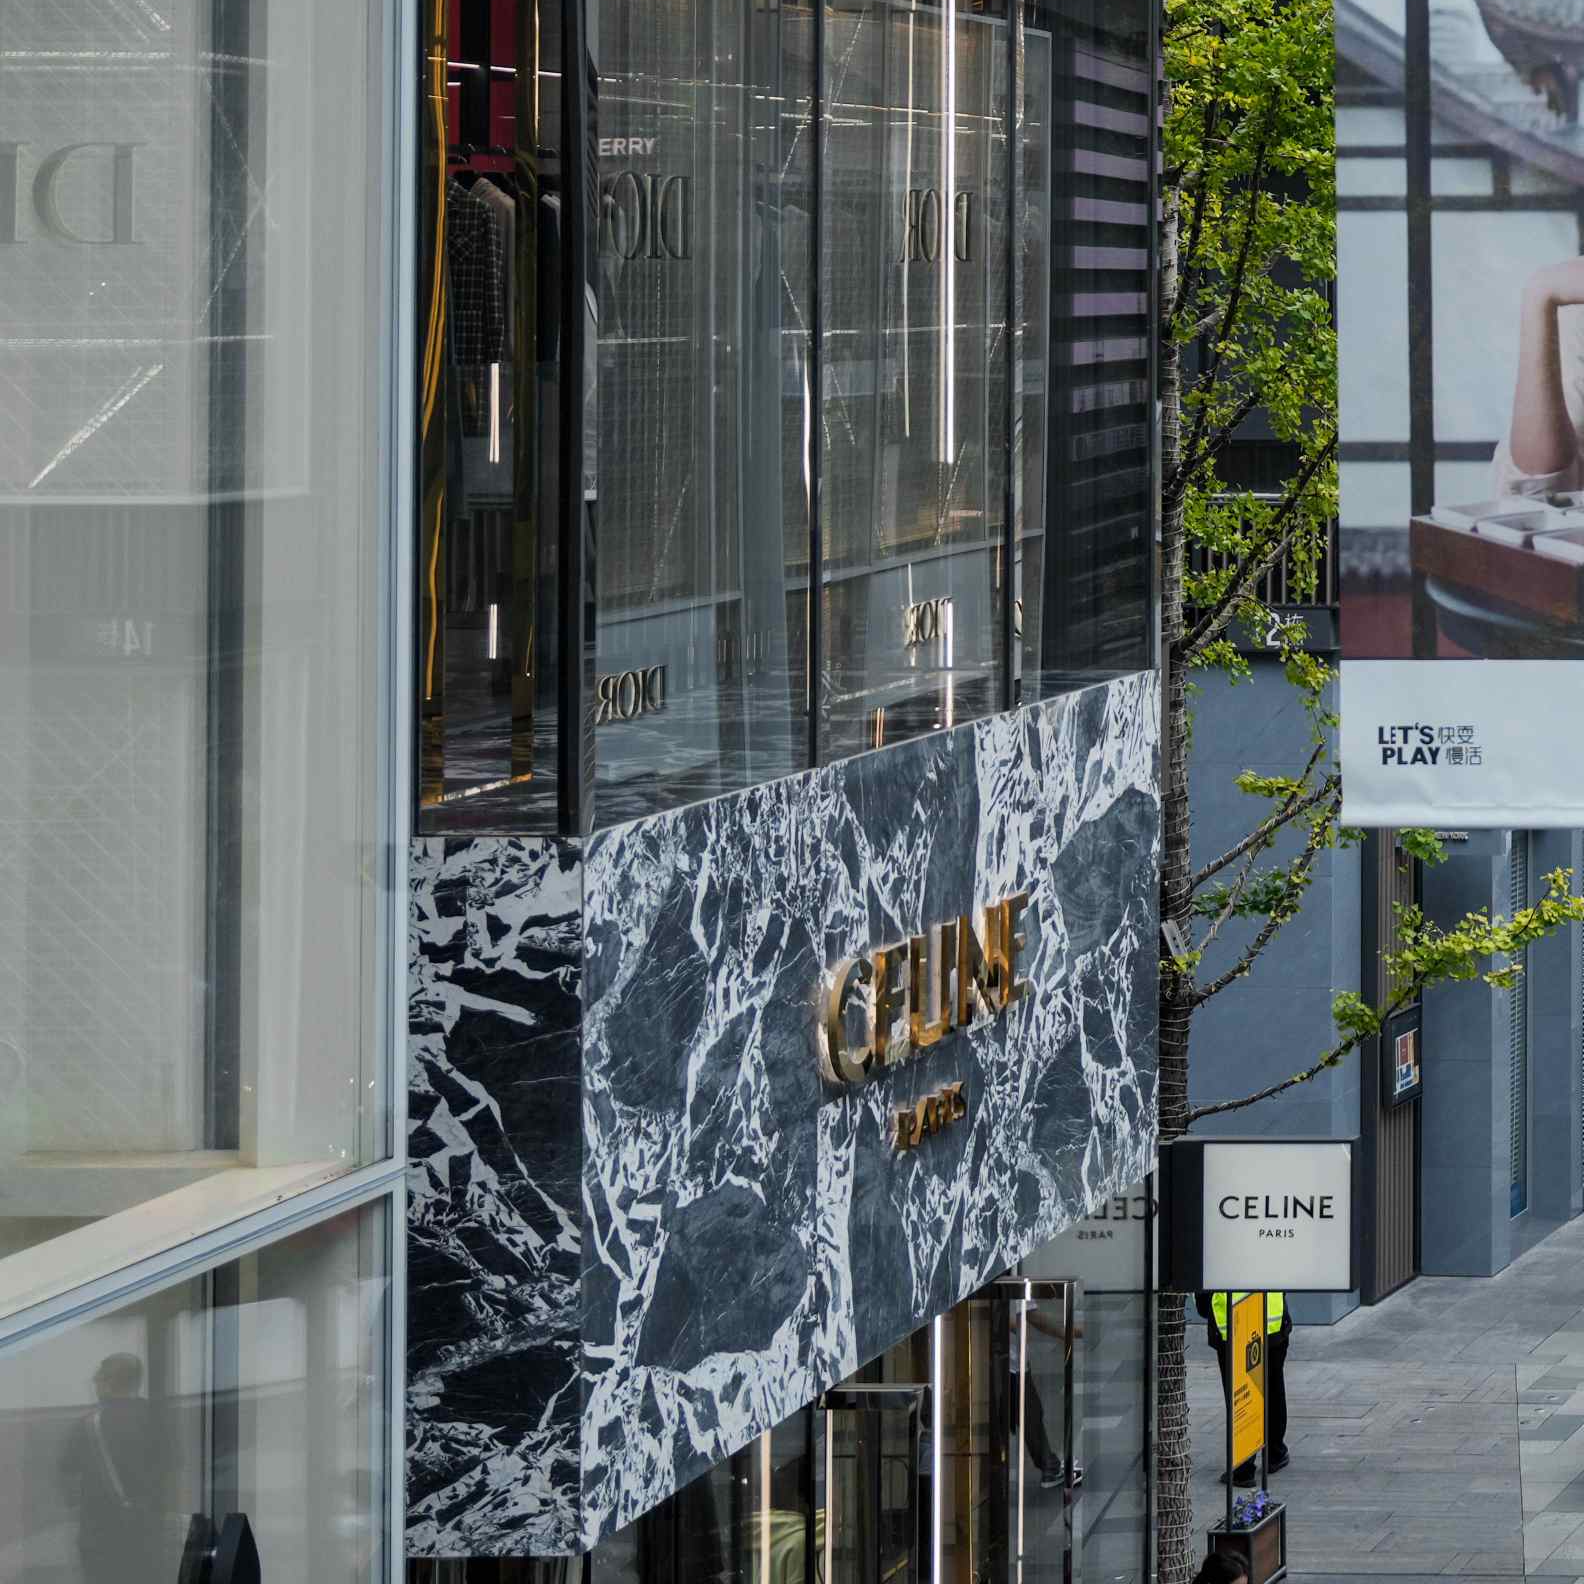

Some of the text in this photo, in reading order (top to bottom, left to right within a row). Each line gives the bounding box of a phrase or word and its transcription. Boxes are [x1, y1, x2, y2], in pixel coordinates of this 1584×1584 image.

[1378, 723, 1434, 745] LET'S
[1381, 747, 1441, 765] PLAY
[818, 891, 1034, 1084] CELINE
[1219, 1195, 1334, 1220] CELINE
[1258, 1228, 1295, 1238] PARIS
